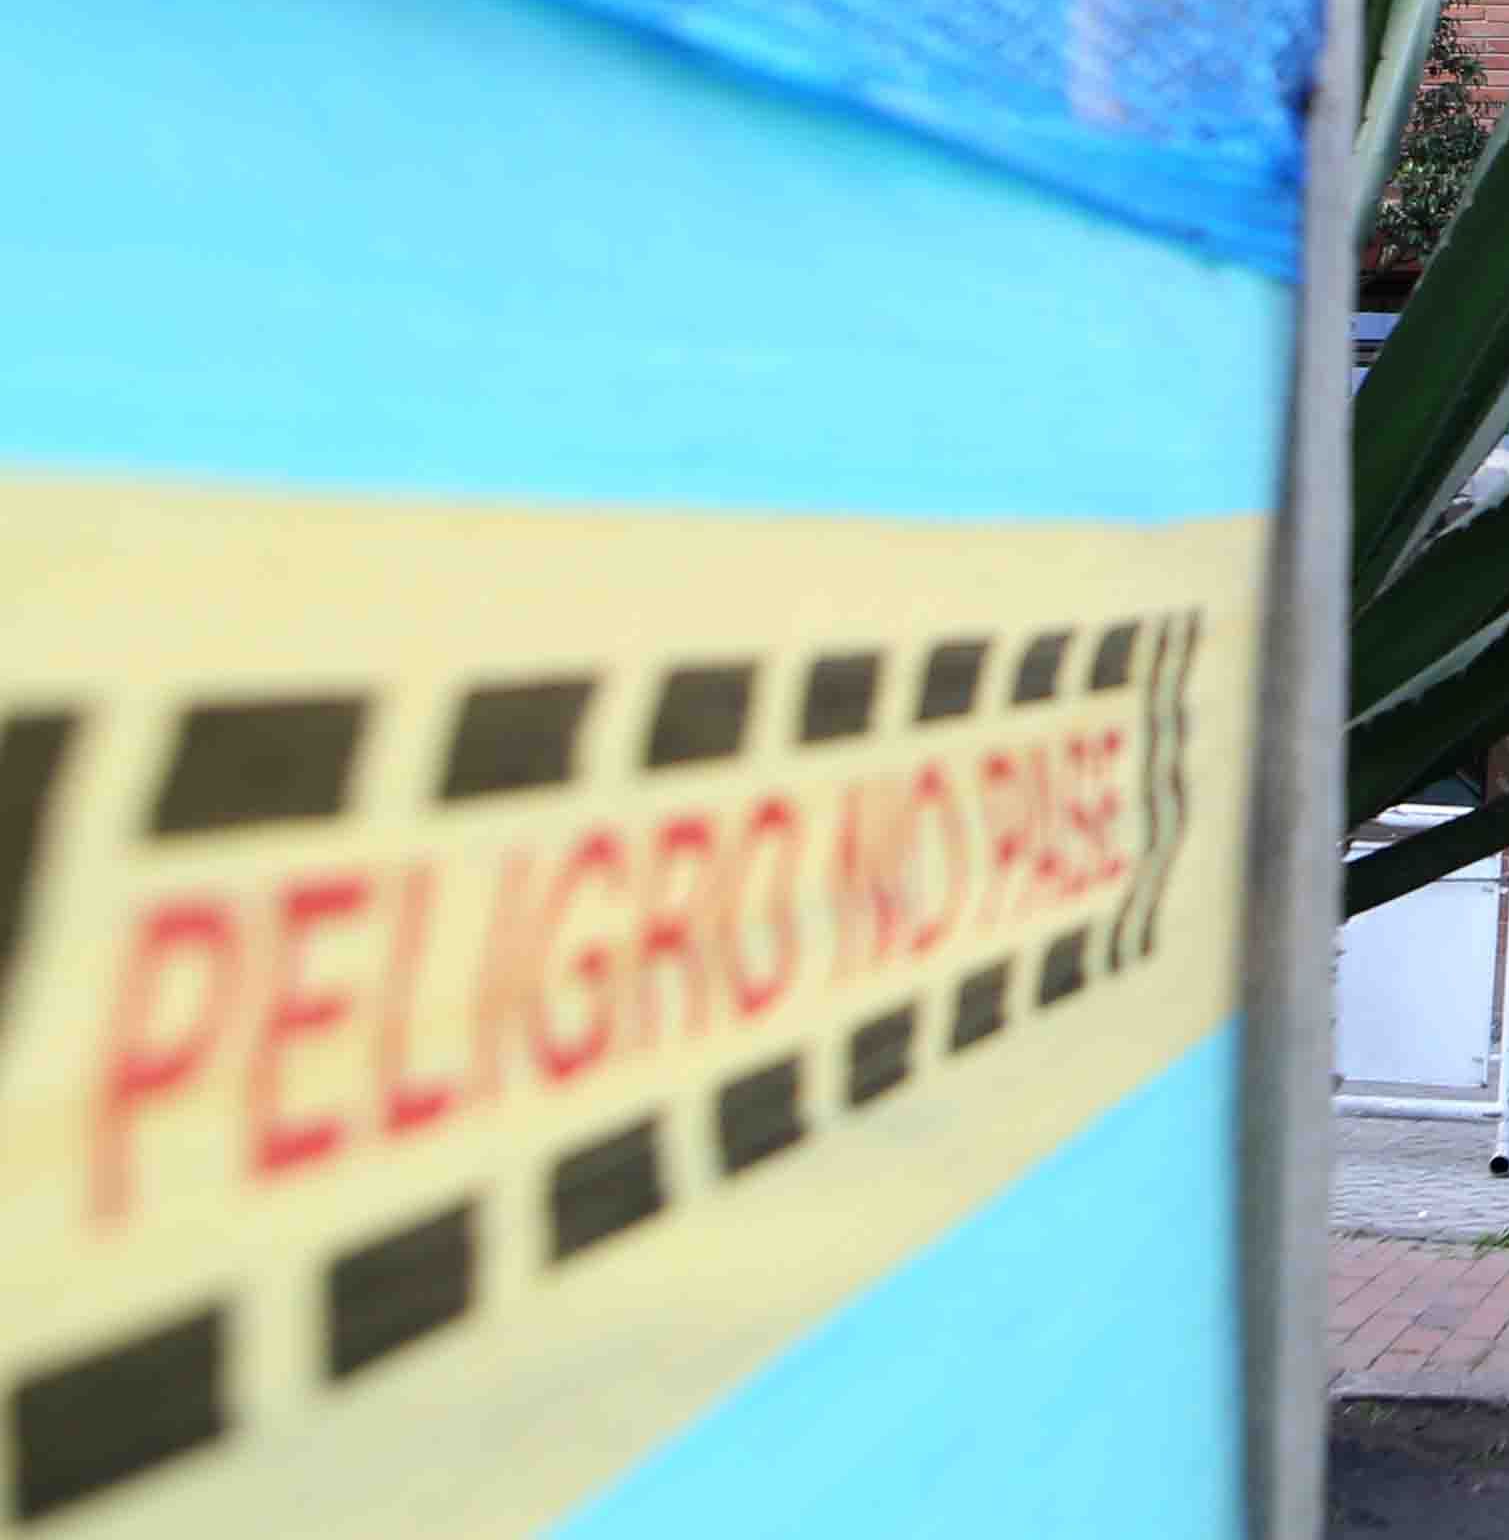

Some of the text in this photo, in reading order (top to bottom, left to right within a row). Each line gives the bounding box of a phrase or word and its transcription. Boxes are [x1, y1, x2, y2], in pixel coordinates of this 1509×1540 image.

[80, 722, 1130, 1236] PELIGRO NO PASE
